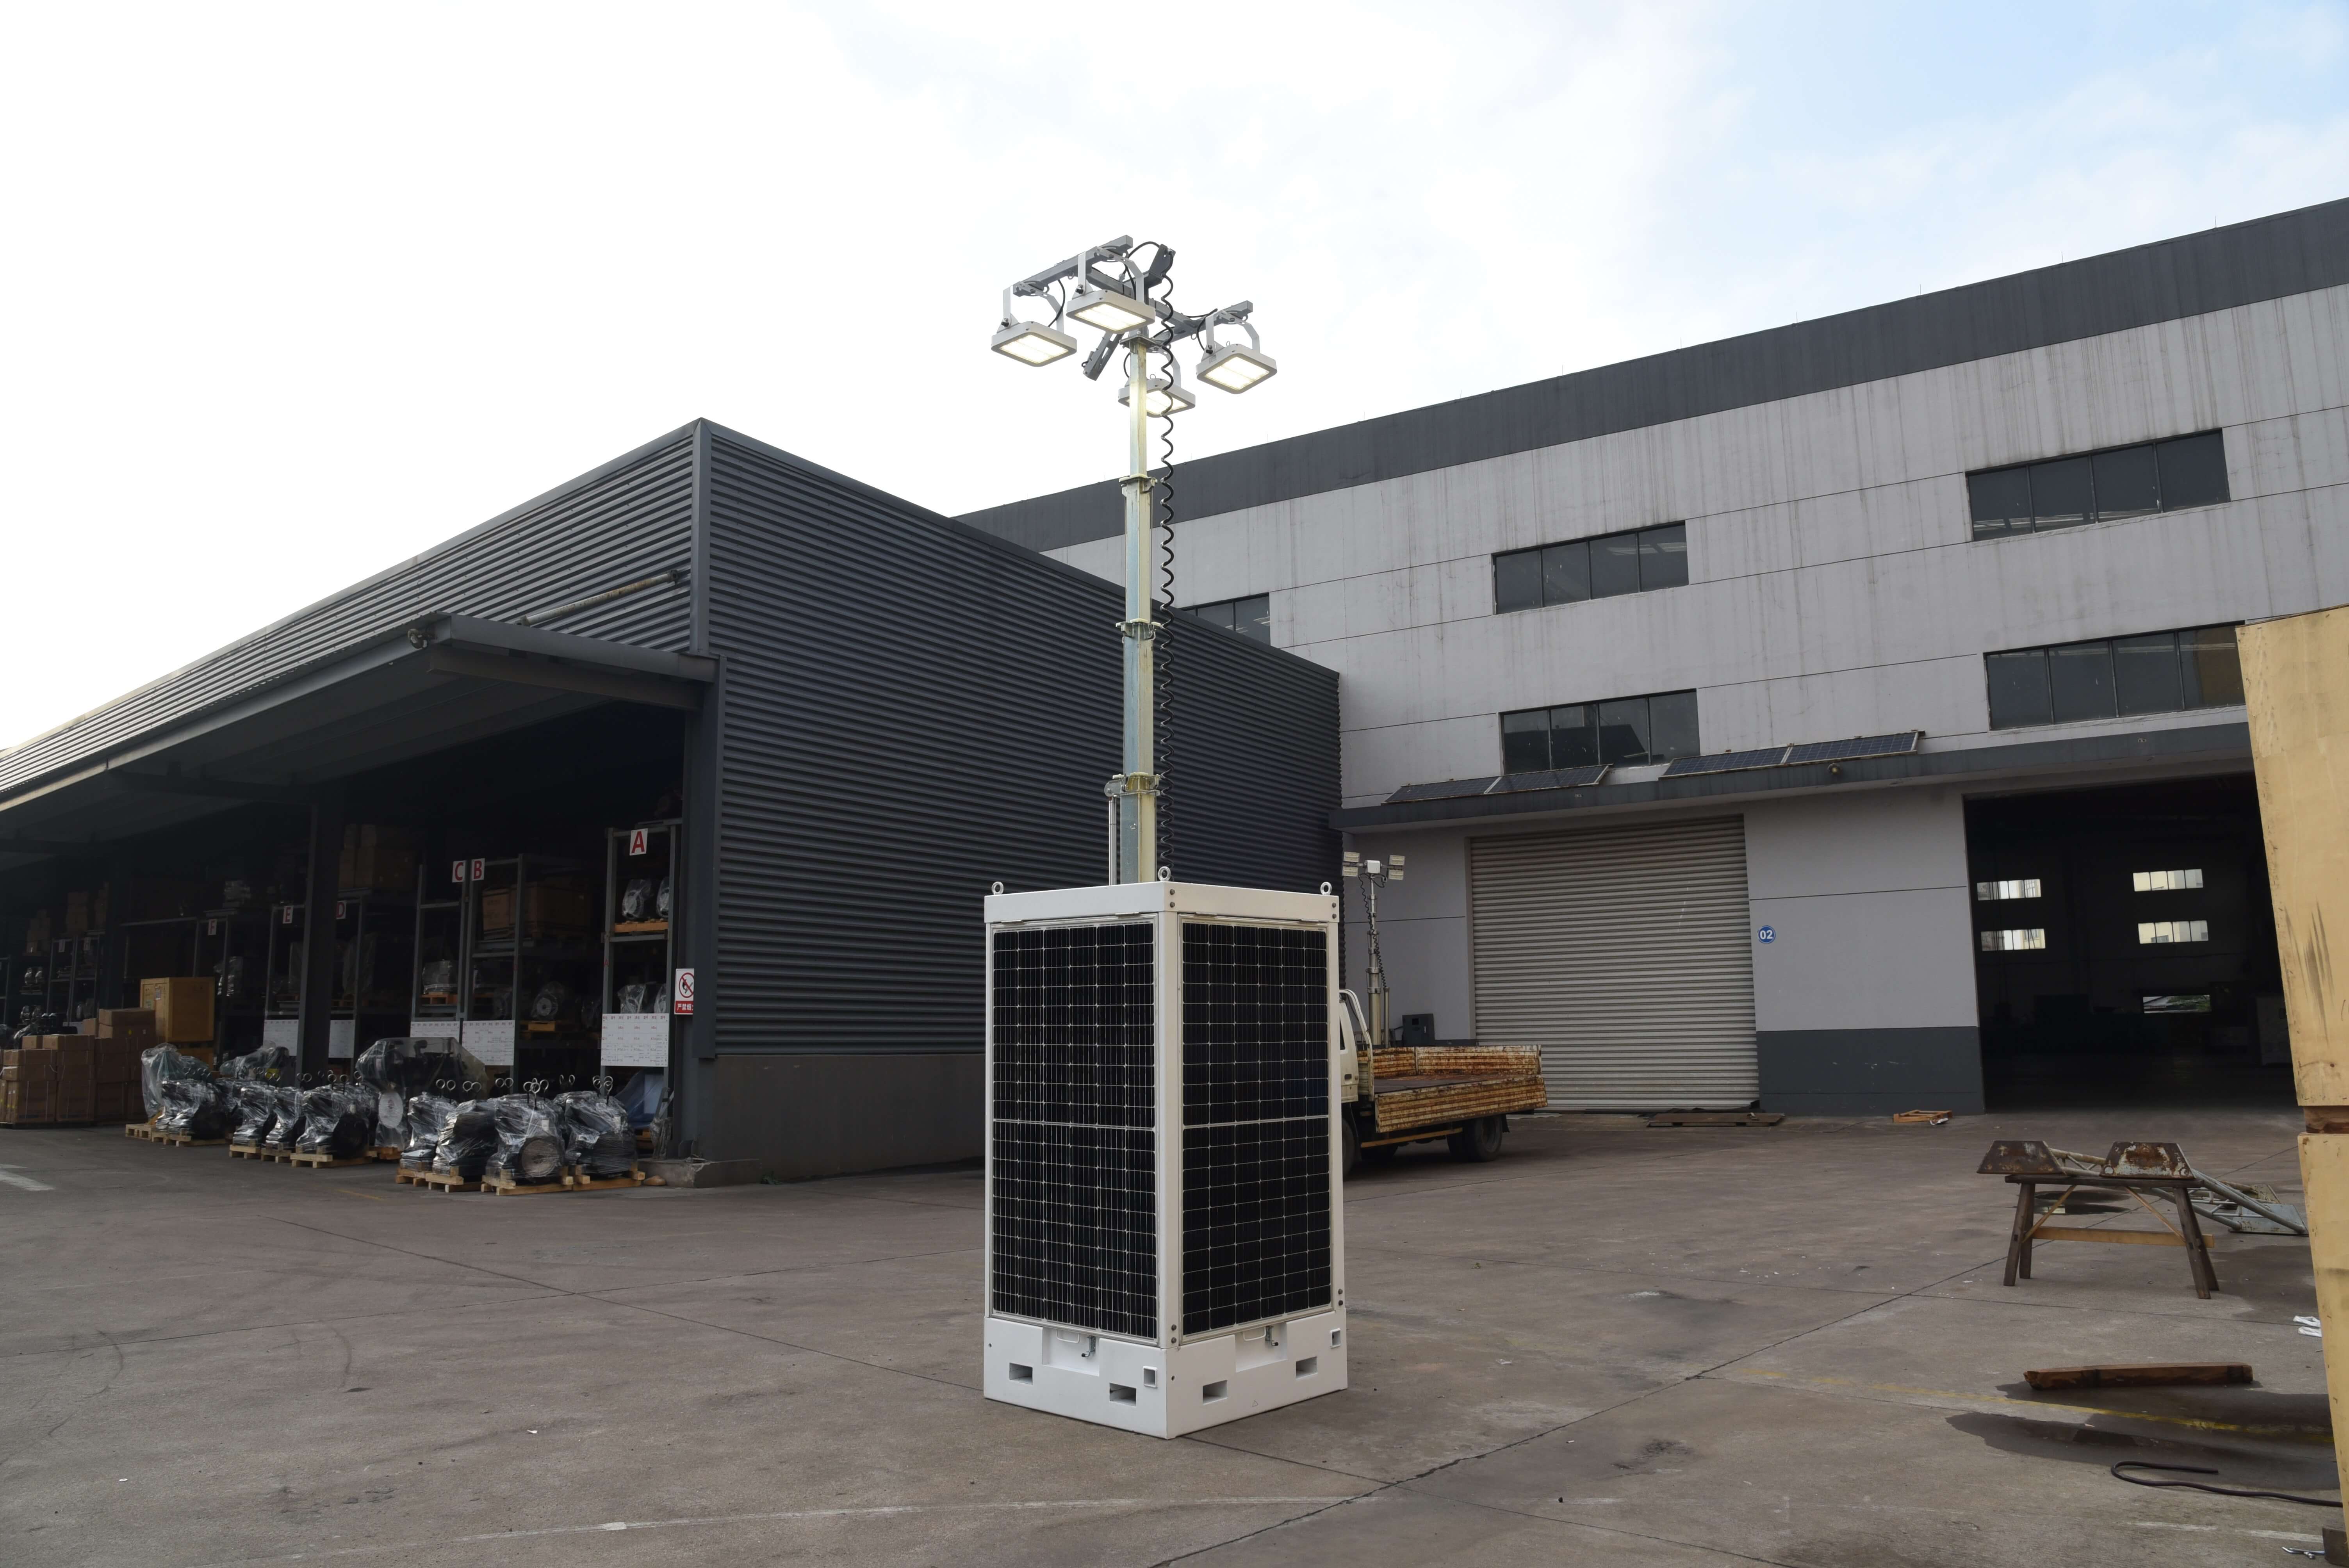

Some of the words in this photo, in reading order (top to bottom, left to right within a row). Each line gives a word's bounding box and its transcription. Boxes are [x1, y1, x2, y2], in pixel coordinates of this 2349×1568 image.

[631, 831, 645, 853] A
[455, 862, 463, 881] C
[474, 861, 482, 879] B
[285, 907, 291, 922] E
[337, 902, 345, 918] D
[210, 920, 215, 934] F
[1759, 930, 1773, 939] 02
